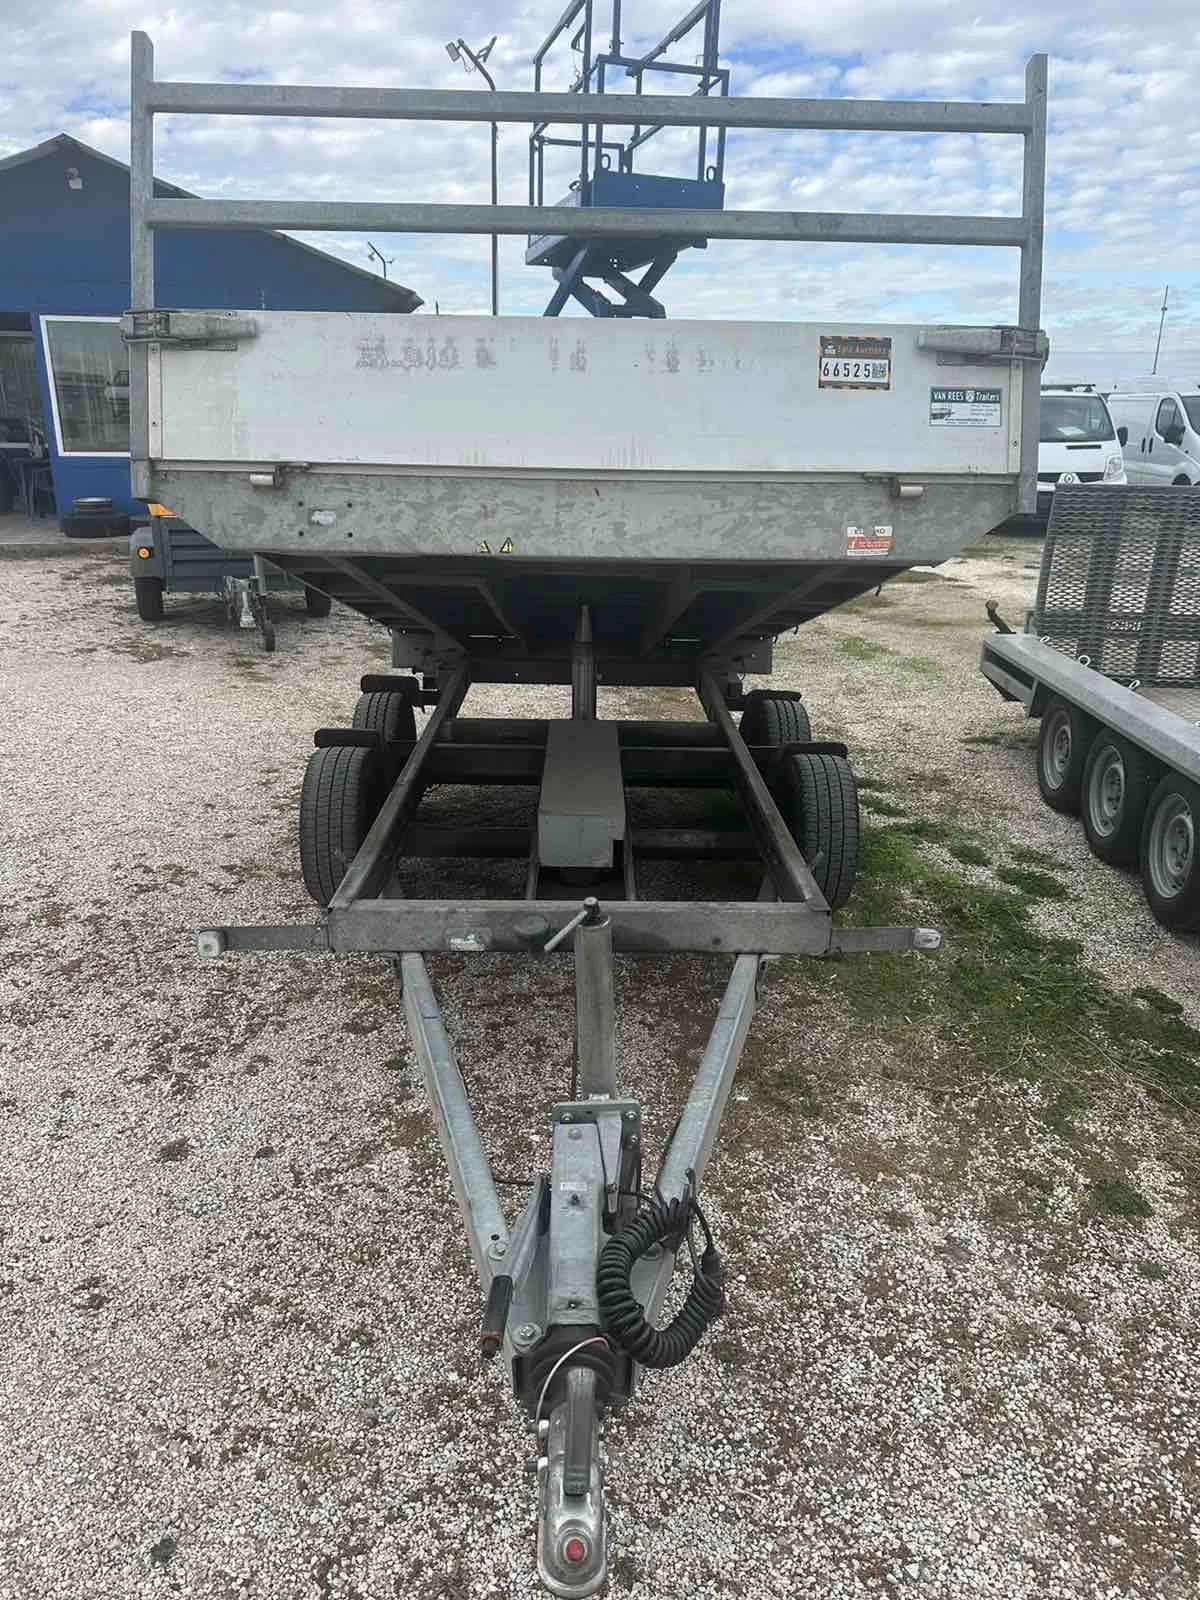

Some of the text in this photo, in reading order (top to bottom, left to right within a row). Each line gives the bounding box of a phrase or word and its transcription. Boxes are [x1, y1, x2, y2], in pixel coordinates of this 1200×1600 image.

[823, 361, 871, 378] 66525
[932, 391, 1000, 401] VAN REES Trailers
